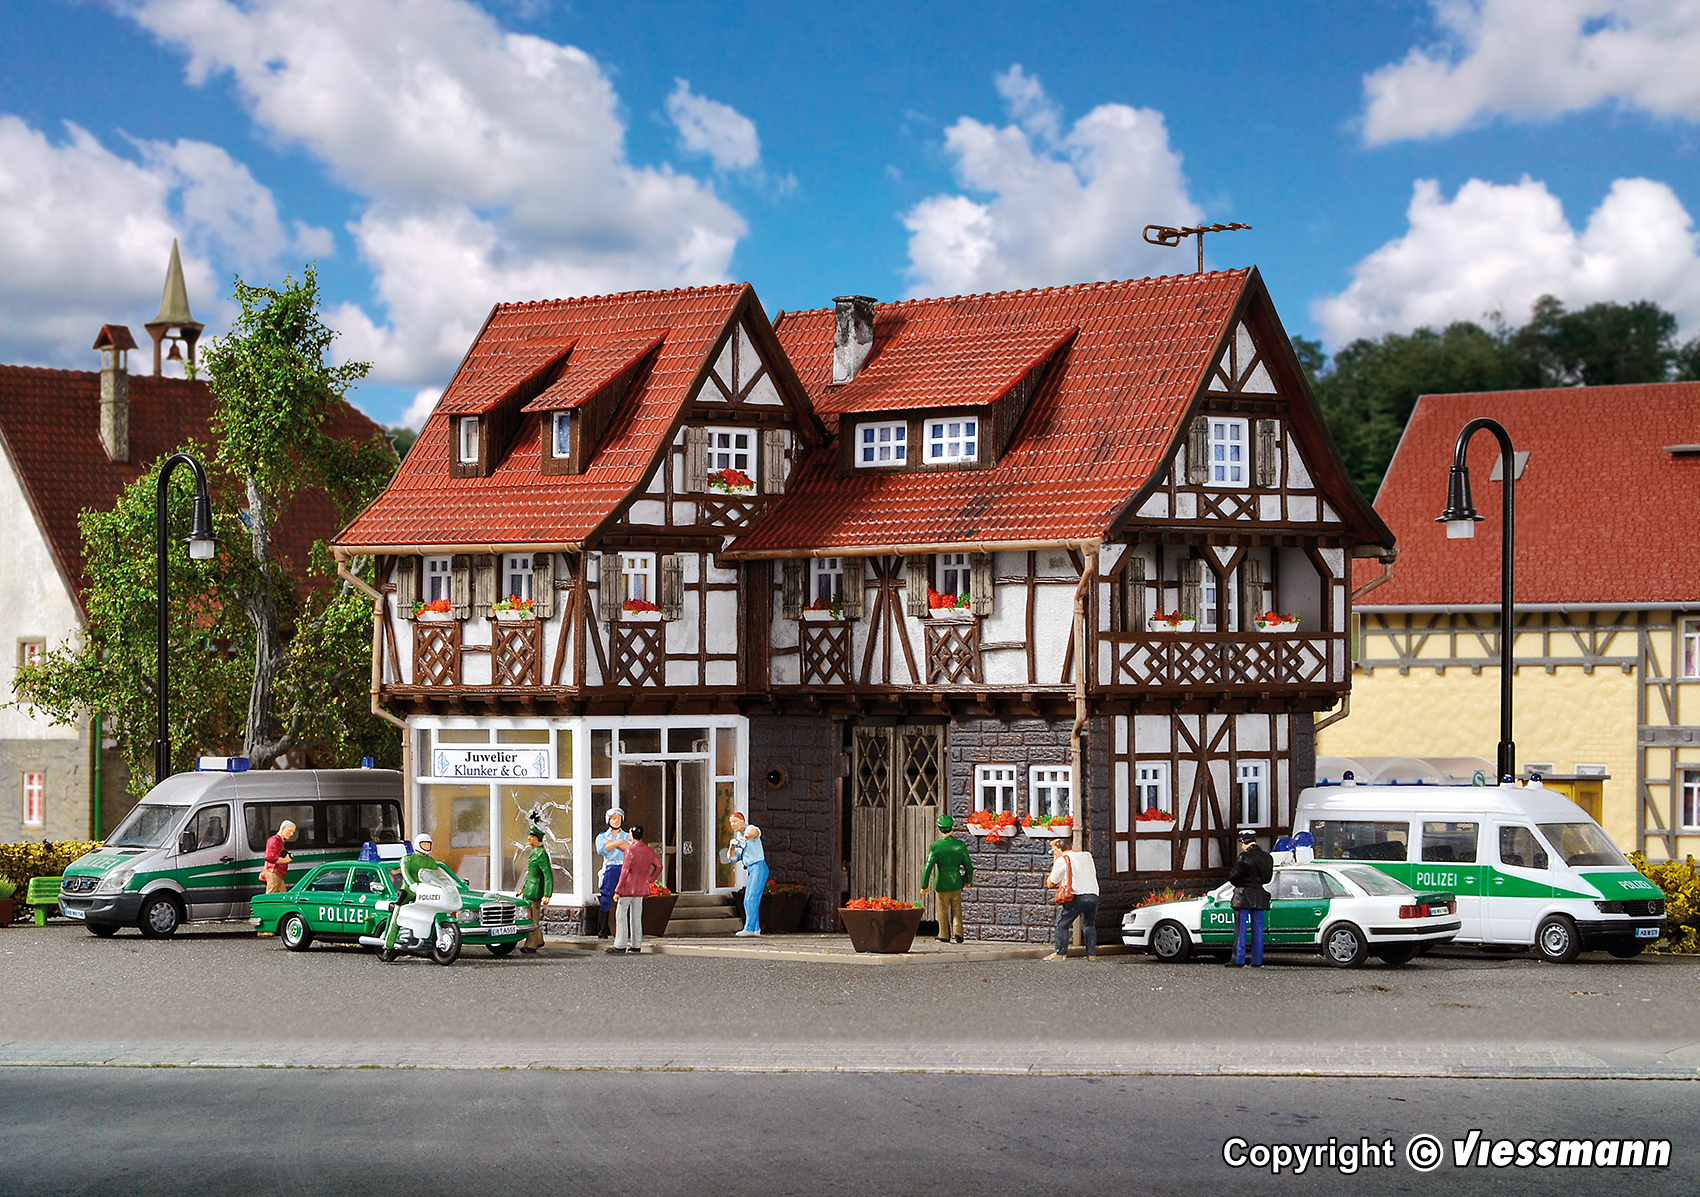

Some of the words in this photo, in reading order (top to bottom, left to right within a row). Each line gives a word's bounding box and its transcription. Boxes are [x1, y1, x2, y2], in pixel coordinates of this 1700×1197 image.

[464, 751, 518, 763] Juwelier
[454, 764, 498, 776] Klunker
[500, 765, 510, 776] &
[512, 764, 528, 776] Co
[1416, 871, 1458, 887] POLIZEI
[1617, 880, 1654, 890] POLIZEI
[318, 906, 369, 923] POLIZEI
[1210, 912, 1251, 924] POLII
